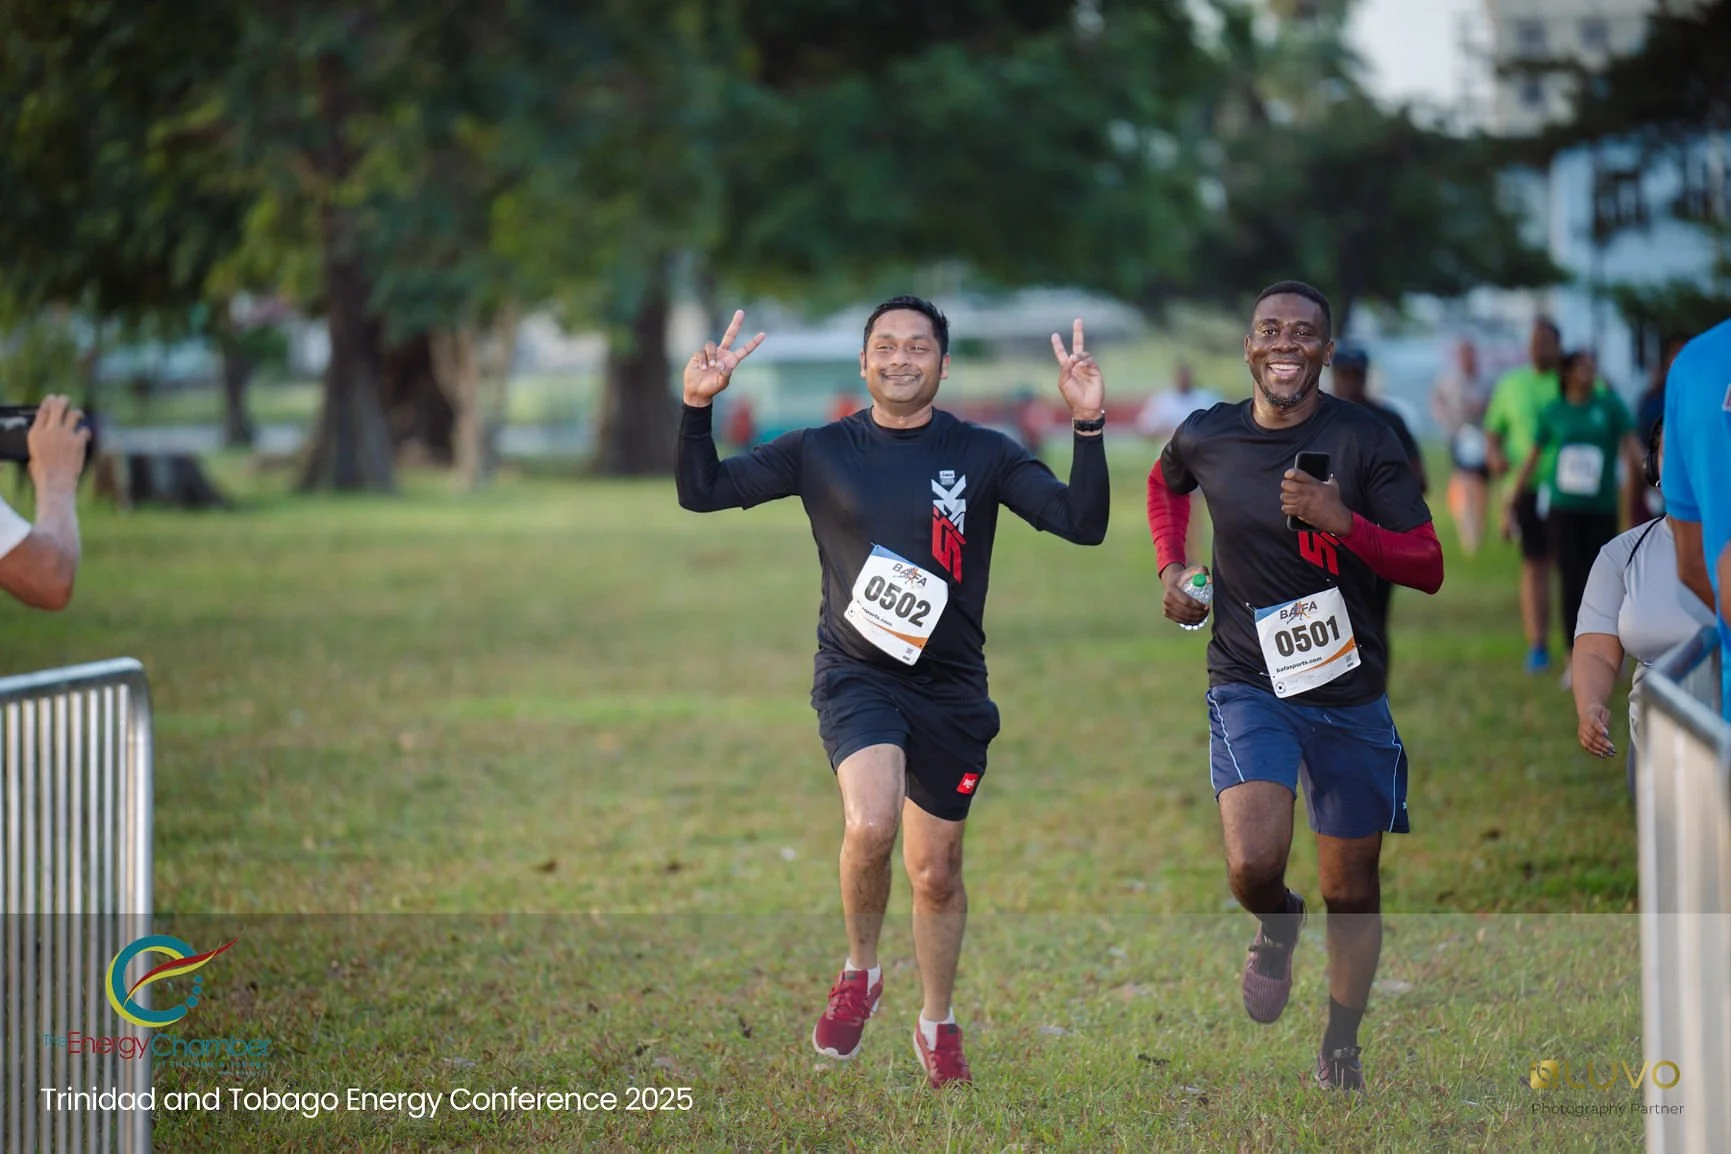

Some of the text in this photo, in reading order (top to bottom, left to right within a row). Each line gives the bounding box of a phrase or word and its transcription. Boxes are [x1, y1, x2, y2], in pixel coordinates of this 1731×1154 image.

[864, 575, 932, 628] 0502
[1280, 601, 1318, 620] BAFA
[1275, 615, 1341, 657] 0501
[1276, 656, 1322, 674] bafasports.com
